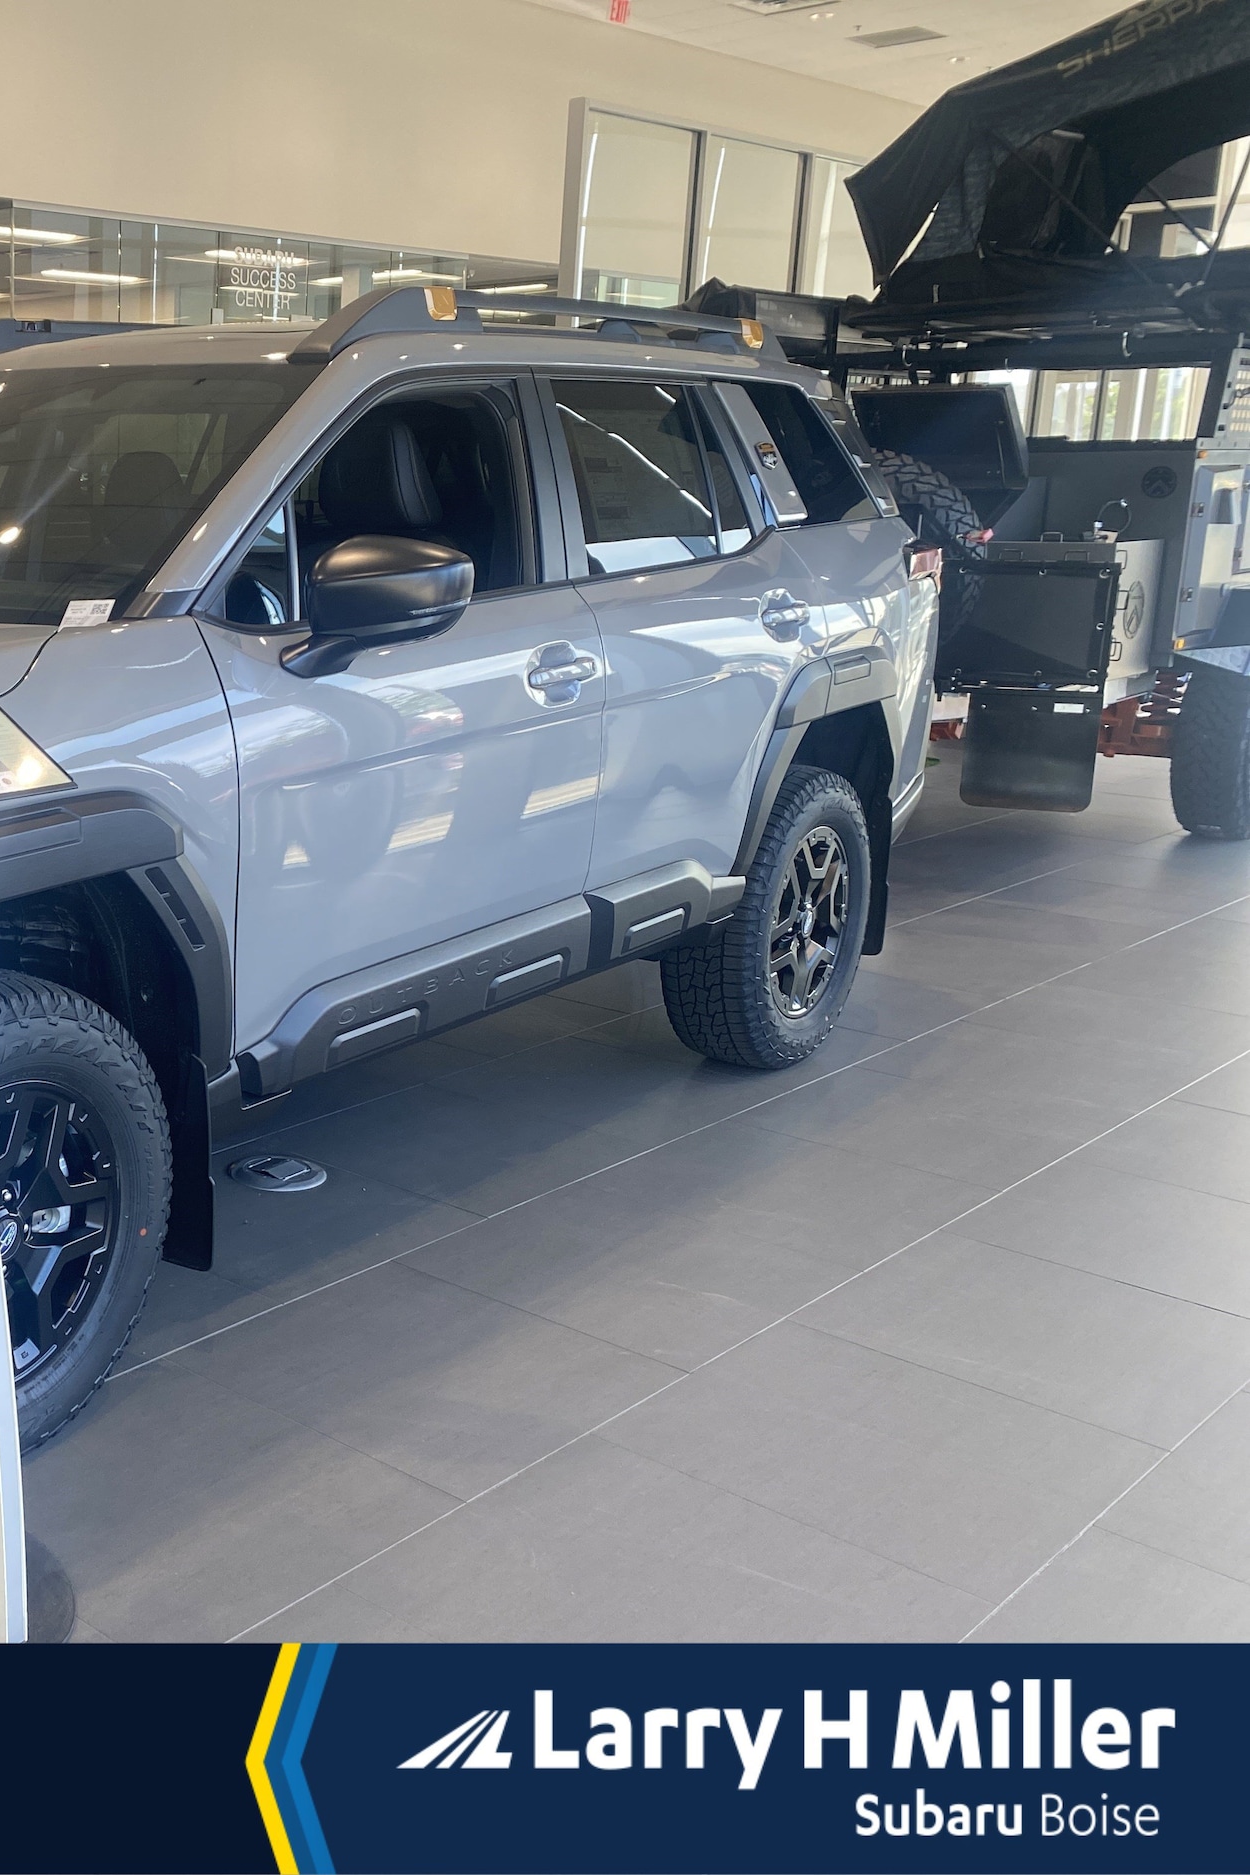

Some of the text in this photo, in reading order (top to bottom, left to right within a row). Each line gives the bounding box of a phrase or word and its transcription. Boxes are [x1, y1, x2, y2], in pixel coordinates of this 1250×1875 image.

[234, 246, 295, 268] SUBARU
[231, 267, 296, 289] SUCCESS
[338, 949, 514, 1026] OUTBACK
